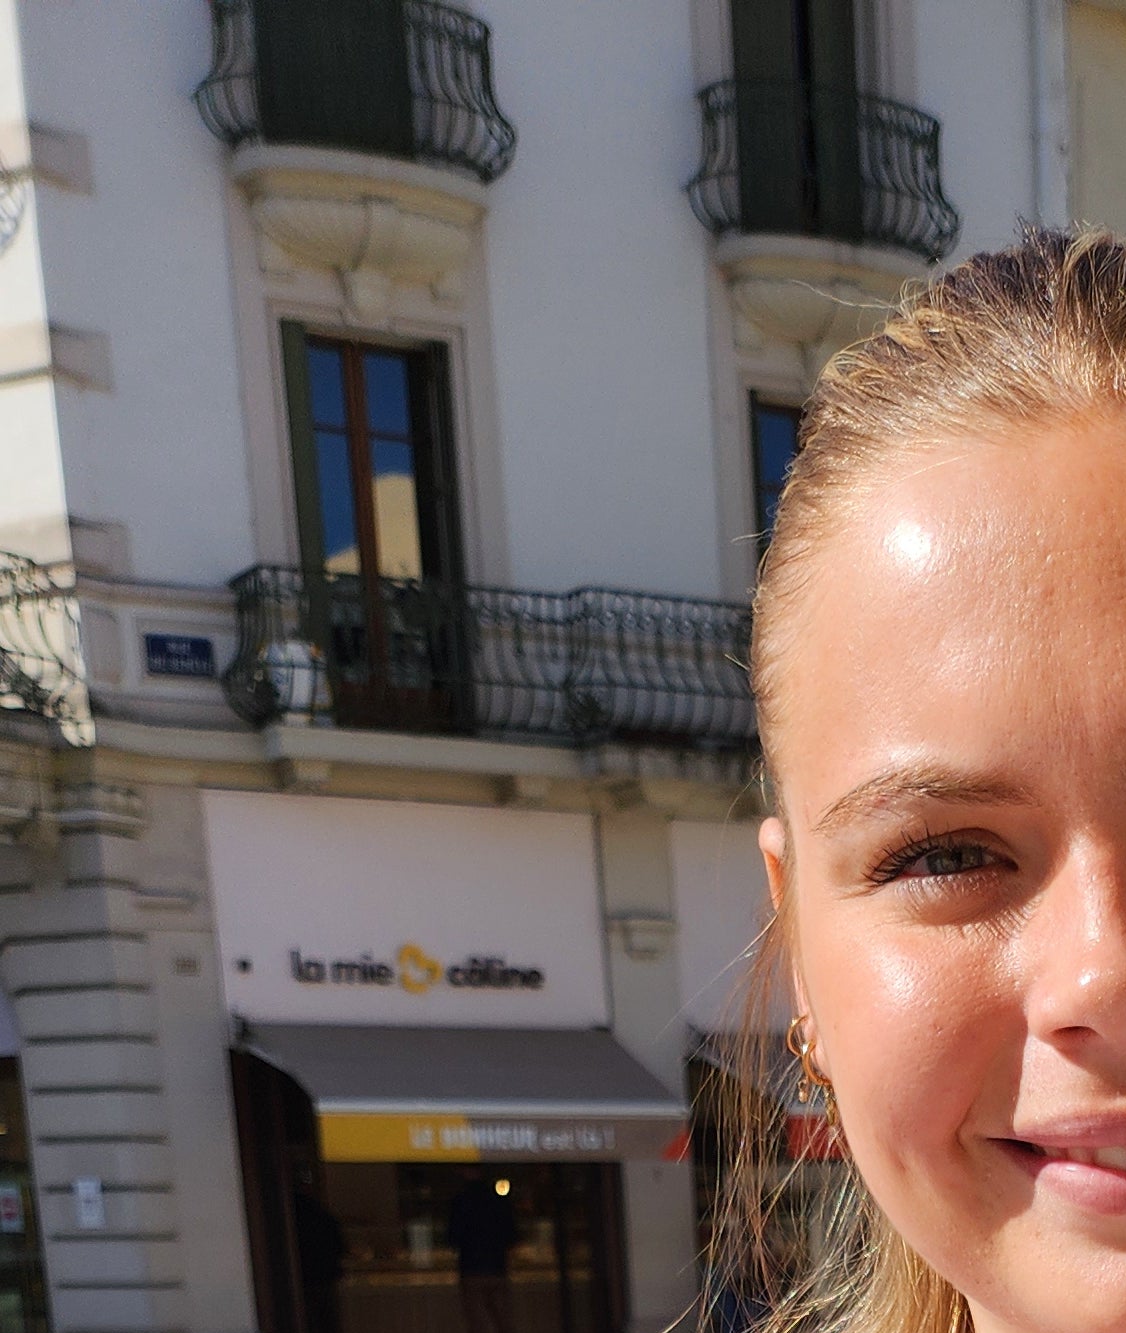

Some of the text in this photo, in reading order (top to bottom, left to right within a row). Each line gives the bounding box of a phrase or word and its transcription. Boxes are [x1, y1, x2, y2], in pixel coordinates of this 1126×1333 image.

[288, 946, 545, 989] la mie câline
